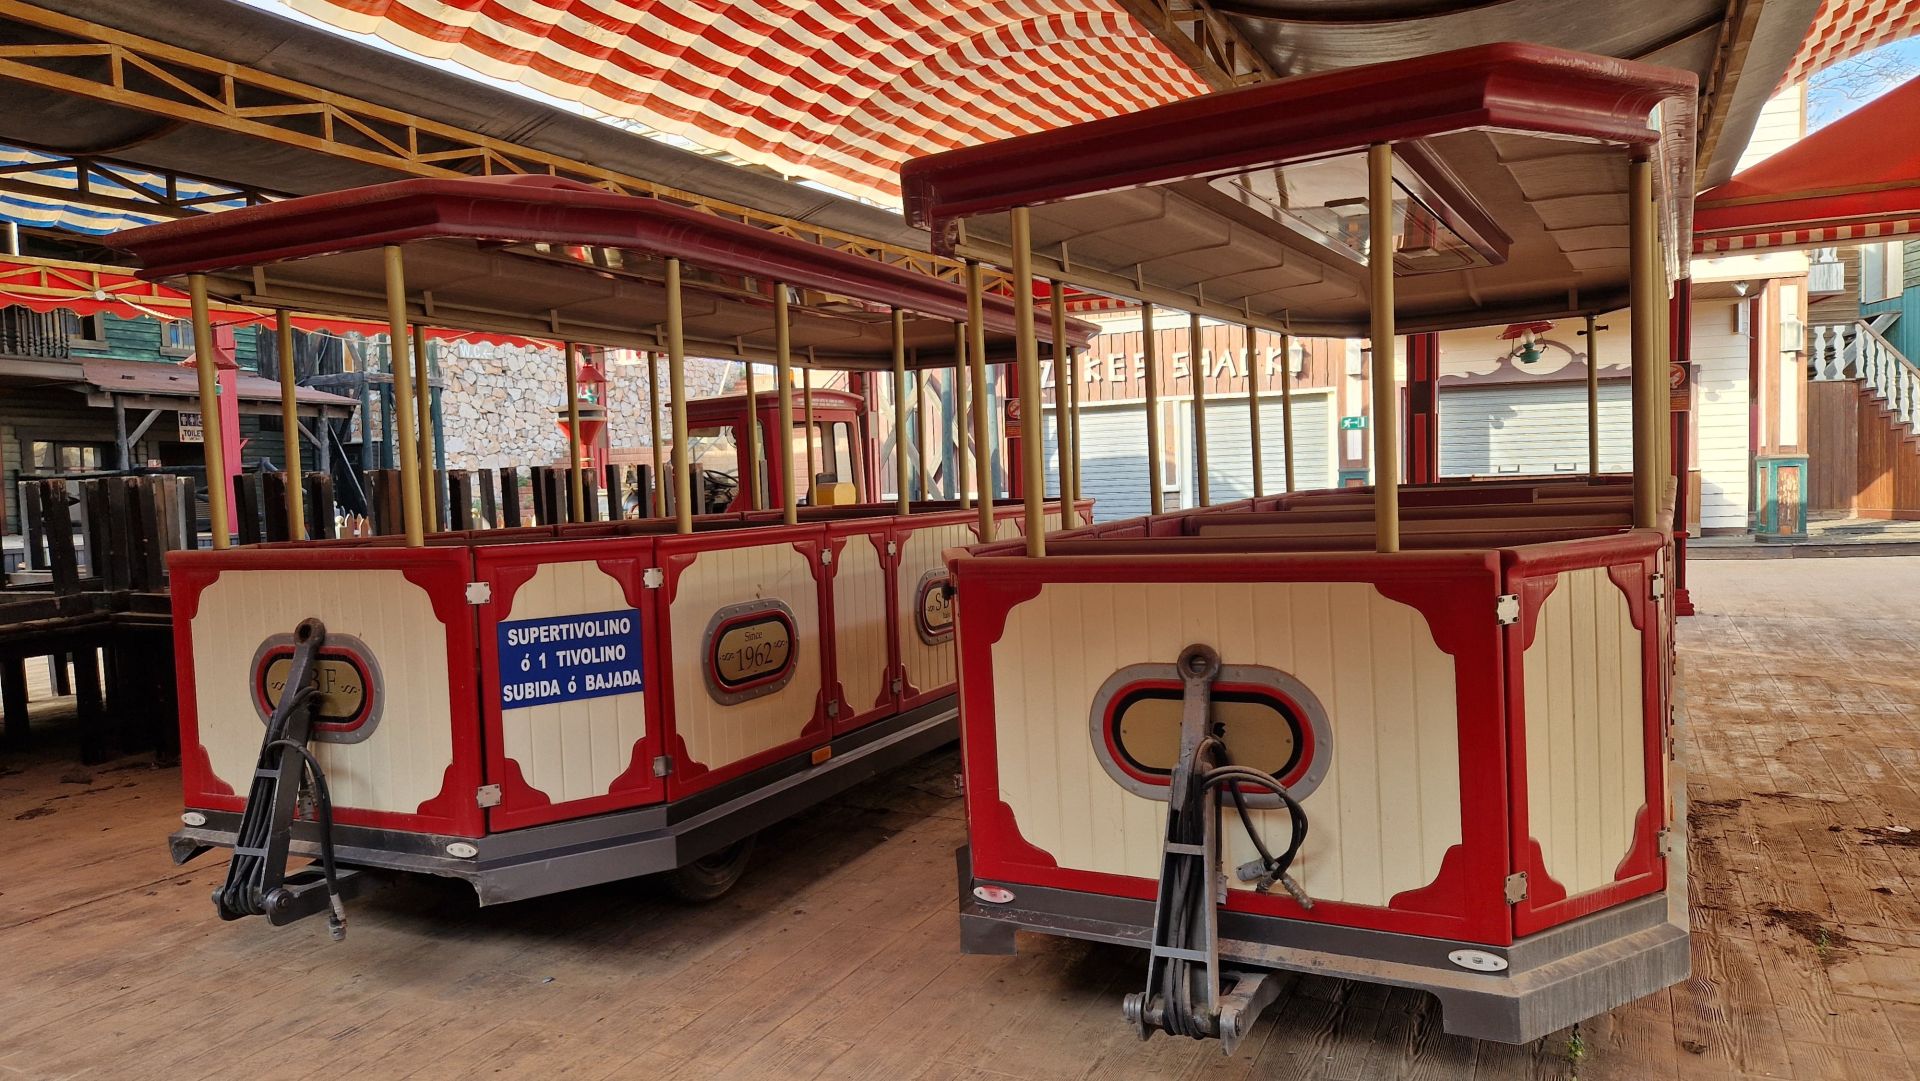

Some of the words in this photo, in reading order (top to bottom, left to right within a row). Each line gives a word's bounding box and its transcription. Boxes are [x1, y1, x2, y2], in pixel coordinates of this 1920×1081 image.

[507, 617, 631, 646] SUPERTIVOLINO
[744, 631, 763, 642] Since
[520, 653, 530, 672] ó
[539, 652, 546, 669] 1
[556, 644, 626, 668] TIVOLINO
[736, 642, 773, 671] 1962
[503, 679, 561, 702] SUBIDA
[567, 676, 577, 694] ó
[585, 669, 642, 692] BAJADA
